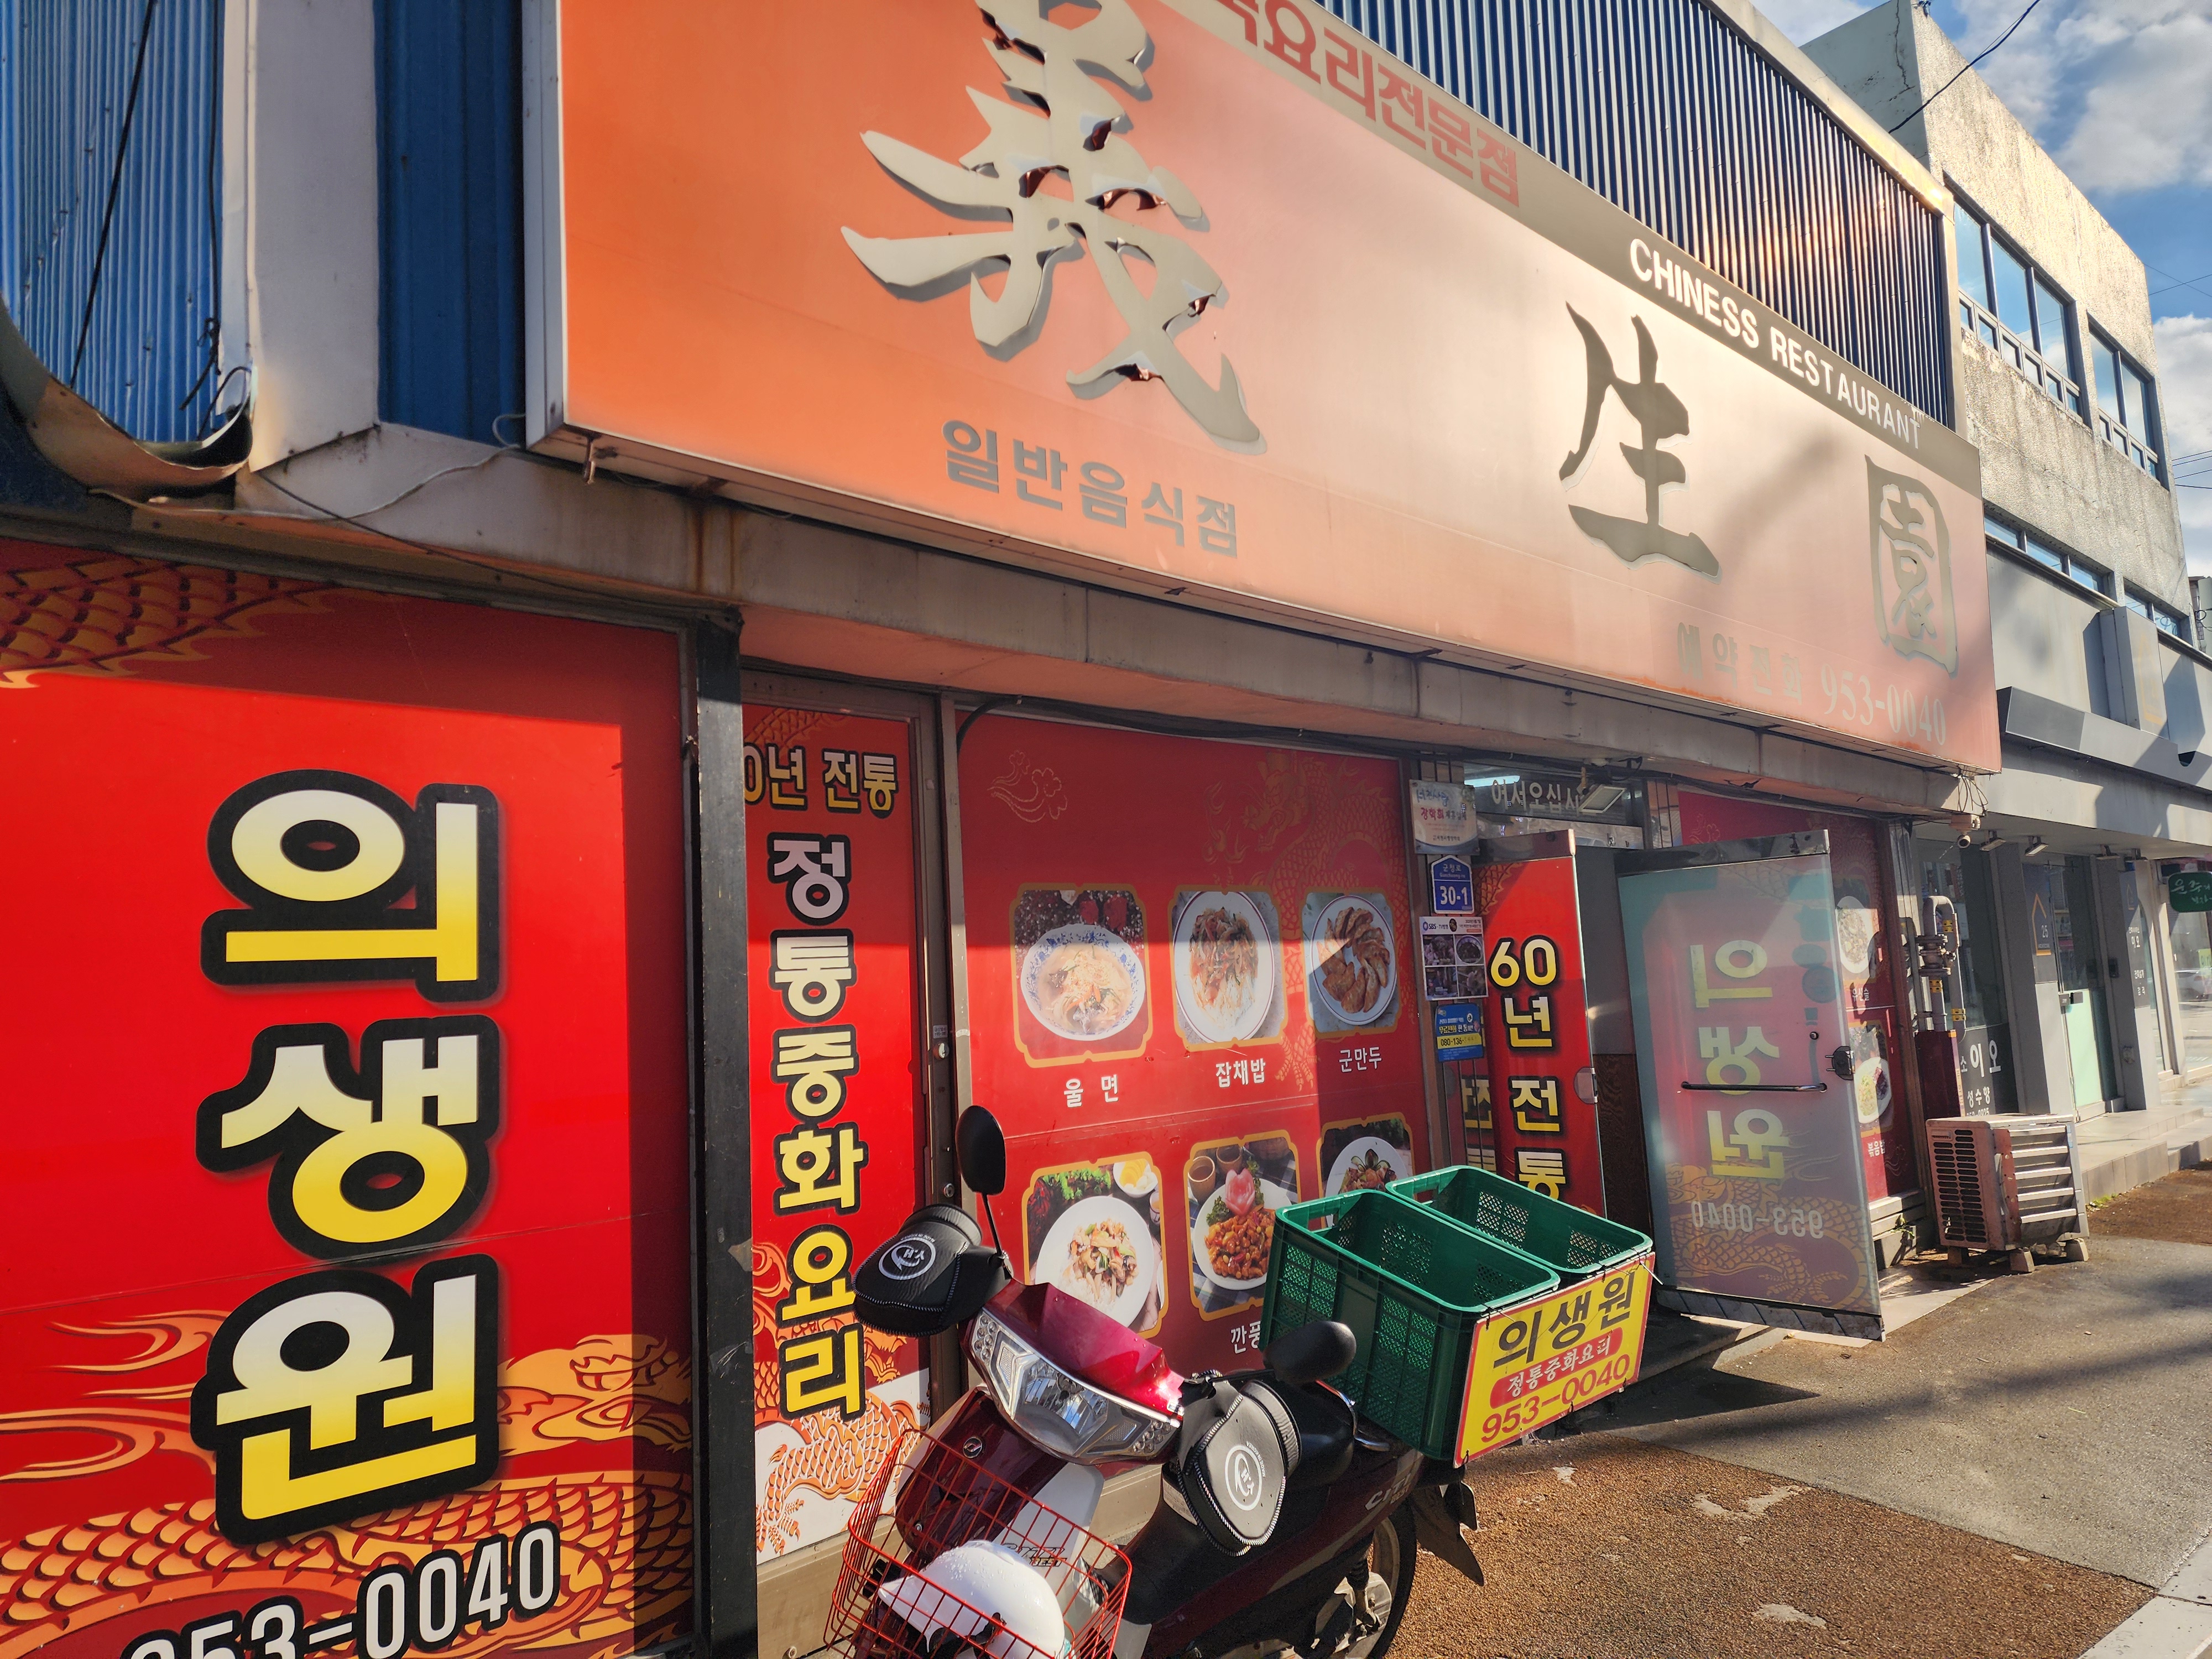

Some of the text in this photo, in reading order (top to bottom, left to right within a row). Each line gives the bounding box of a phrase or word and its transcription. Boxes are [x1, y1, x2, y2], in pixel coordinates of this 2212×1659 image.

[1630, 237, 1923, 451] CHINESS RESTAURANT
[942, 419, 1238, 560] 일반음식점
[1820, 663, 1946, 746] 953-0040
[823, 751, 897, 813] 전통
[1491, 779, 1597, 816] 어서오십시
[1439, 885, 1468, 905] 30-1
[1442, 864, 1462, 873] 군청로
[1852, 987, 1870, 1002] 유산슬
[1215, 1058, 1266, 1088] 잡채밥
[1339, 1046, 1382, 1072] 군만두
[1970, 1039, 2001, 1078] 이오
[210, 782, 483, 1526] 의생원
[1867, 1139, 1886, 1157] 볶음밥
[1493, 1271, 1636, 1369] 의생원
[1507, 1335, 1611, 1397] 정통중화요리
[1481, 1354, 1630, 1443] 953-0040
[128, 1527, 555, 1659] 3-0040
